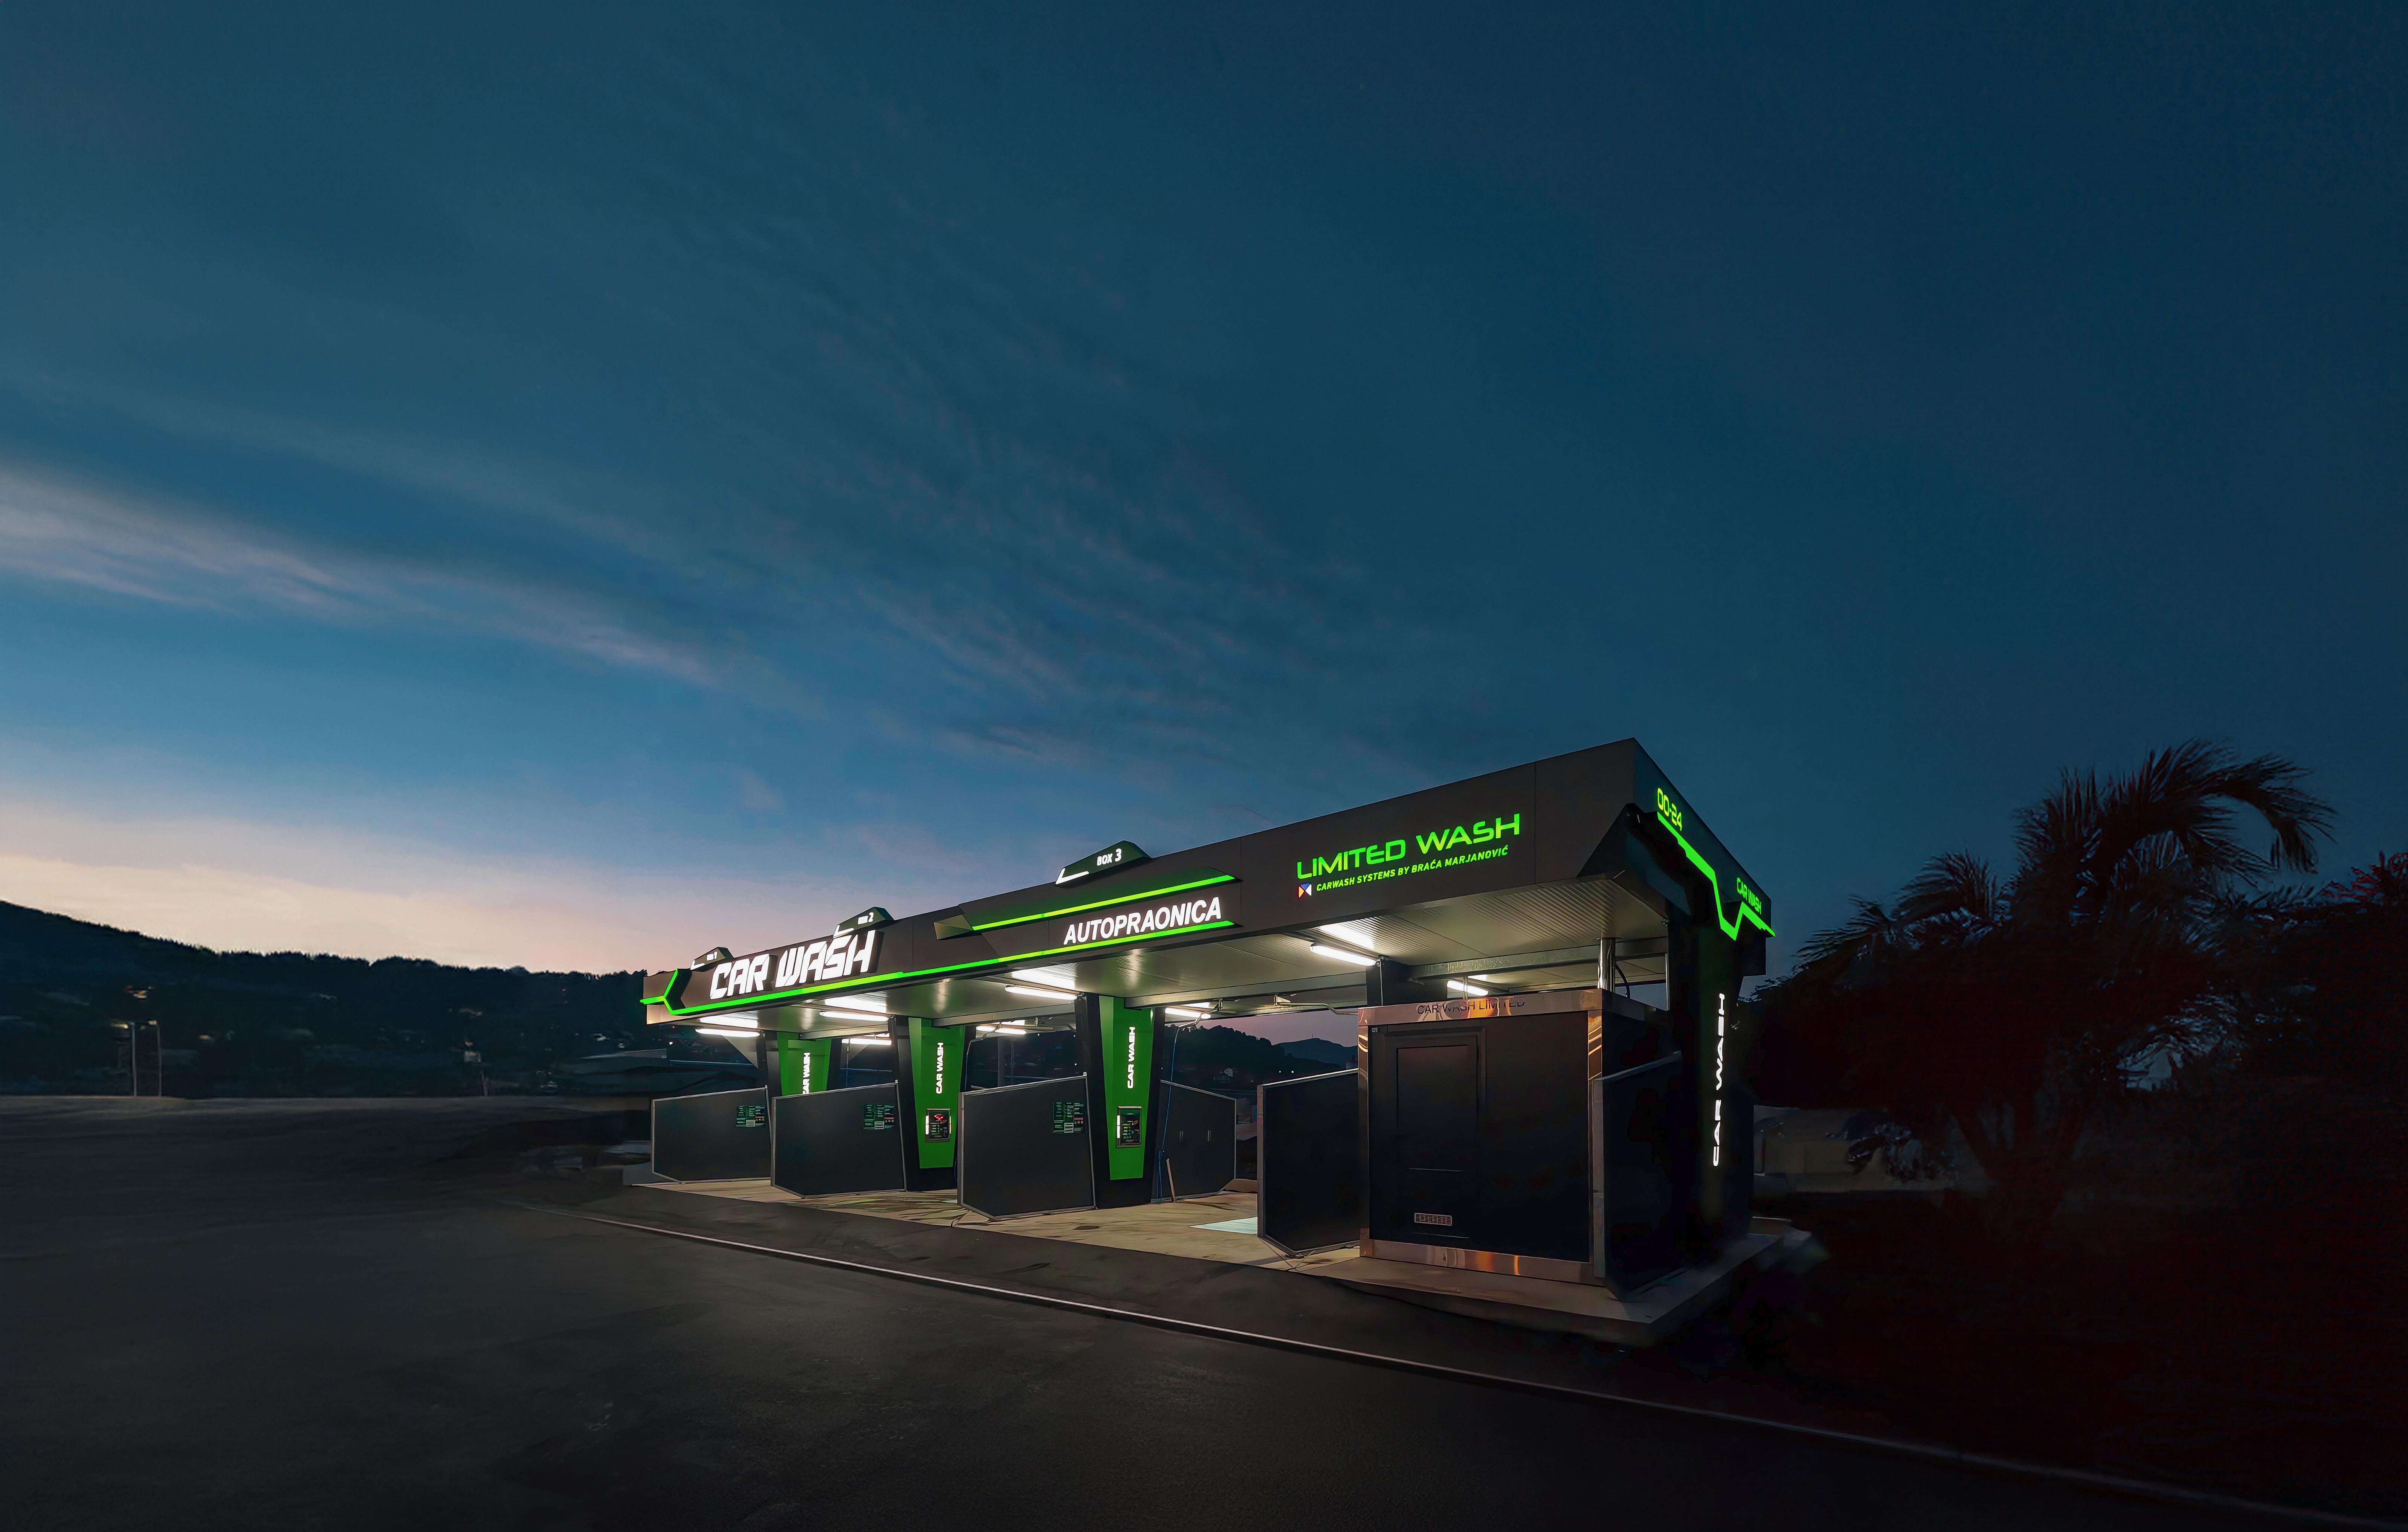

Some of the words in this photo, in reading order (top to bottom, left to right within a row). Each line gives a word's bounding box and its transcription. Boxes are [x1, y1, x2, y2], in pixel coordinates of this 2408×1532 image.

[1657, 787, 1682, 831] 00-24
[1097, 853, 1113, 866] BOX
[1115, 848, 1122, 862] 3
[1297, 839, 1406, 880] LIMITED
[1416, 813, 1520, 855] WASH
[1316, 876, 1355, 891] CARWASH
[1357, 869, 1396, 884] SYSTEMS
[1397, 866, 1410, 876] BY
[1411, 859, 1442, 874] BRAĆA
[1445, 844, 1508, 867] MARJANOVIĆ
[868, 912, 874, 922] 2
[1737, 877, 1747, 901] CAR
[1748, 888, 1761, 915] WASH
[1063, 897, 1222, 945] AUTOPRAONICA
[710, 954, 770, 1000] CAR
[775, 930, 876, 988] WASH
[1417, 1004, 1439, 1015] CAR
[1716, 993, 1725, 1091] WASH
[1713, 1100, 1721, 1166] CAR
